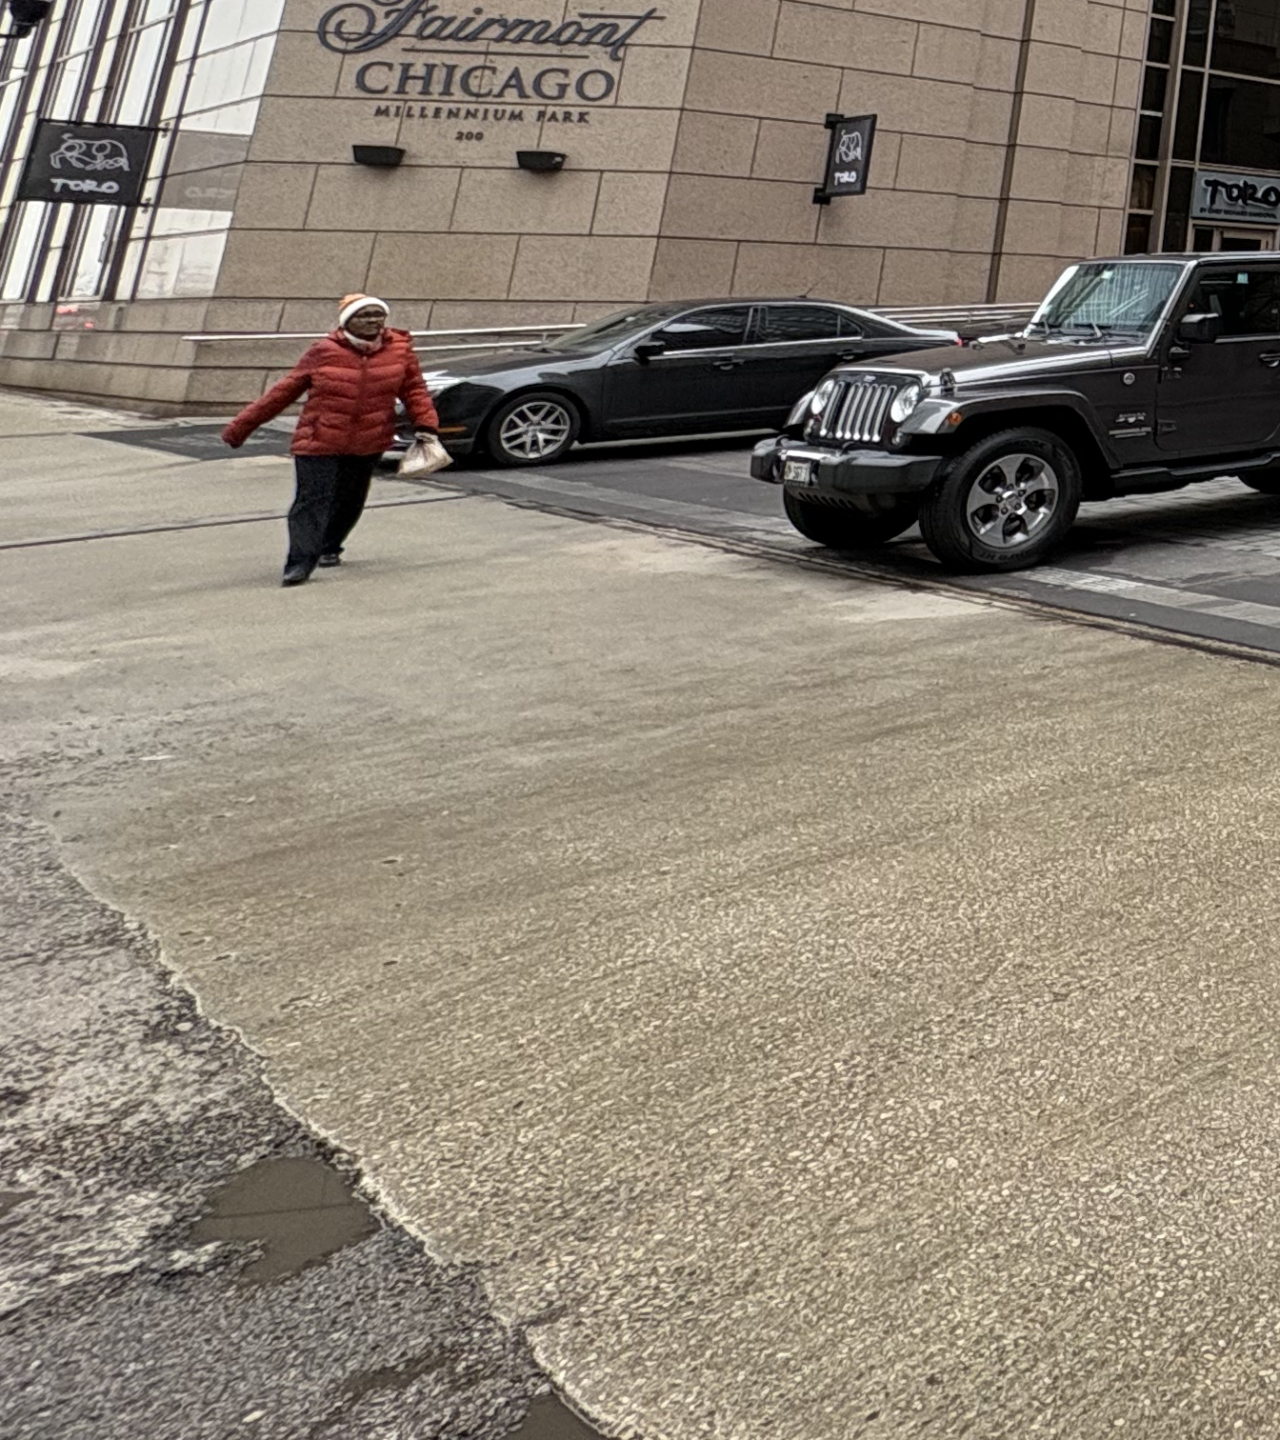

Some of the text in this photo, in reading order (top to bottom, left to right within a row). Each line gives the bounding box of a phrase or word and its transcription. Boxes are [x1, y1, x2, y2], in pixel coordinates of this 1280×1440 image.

[355, 61, 615, 101] CHICAGO
[374, 105, 591, 124] MILLENNIUM PARK
[455, 130, 485, 142] 200
[50, 177, 120, 195] TORO
